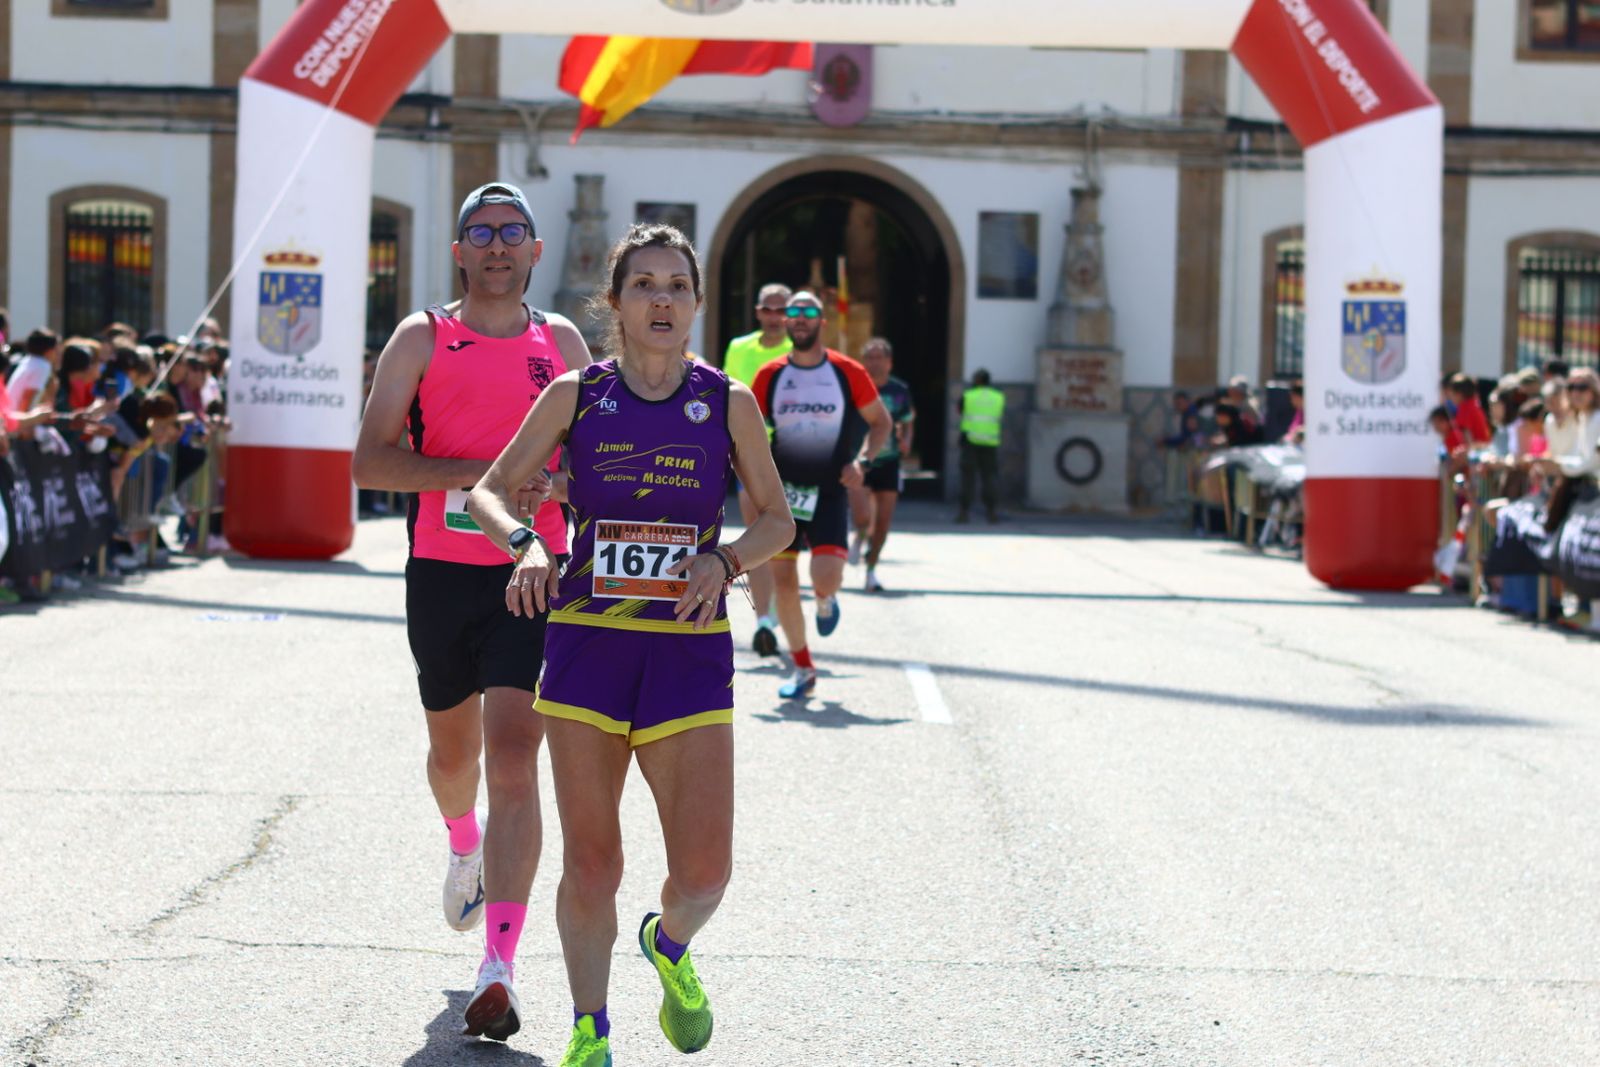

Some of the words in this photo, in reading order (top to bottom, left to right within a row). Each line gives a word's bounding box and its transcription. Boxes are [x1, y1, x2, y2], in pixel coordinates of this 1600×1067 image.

[294, 36, 332, 79] CON
[1303, 19, 1328, 47] EL
[1317, 38, 1381, 114] DEPORTE
[241, 358, 339, 381] Diputación
[250, 385, 345, 408] Salamanca
[1324, 389, 1423, 411] Diputación
[595, 441, 634, 453] Jamón
[655, 455, 696, 470] PRIM
[642, 472, 700, 488] Macotera
[598, 524, 623, 539] XIV
[624, 532, 670, 542] CARRERA
[600, 543, 688, 579] 1671
